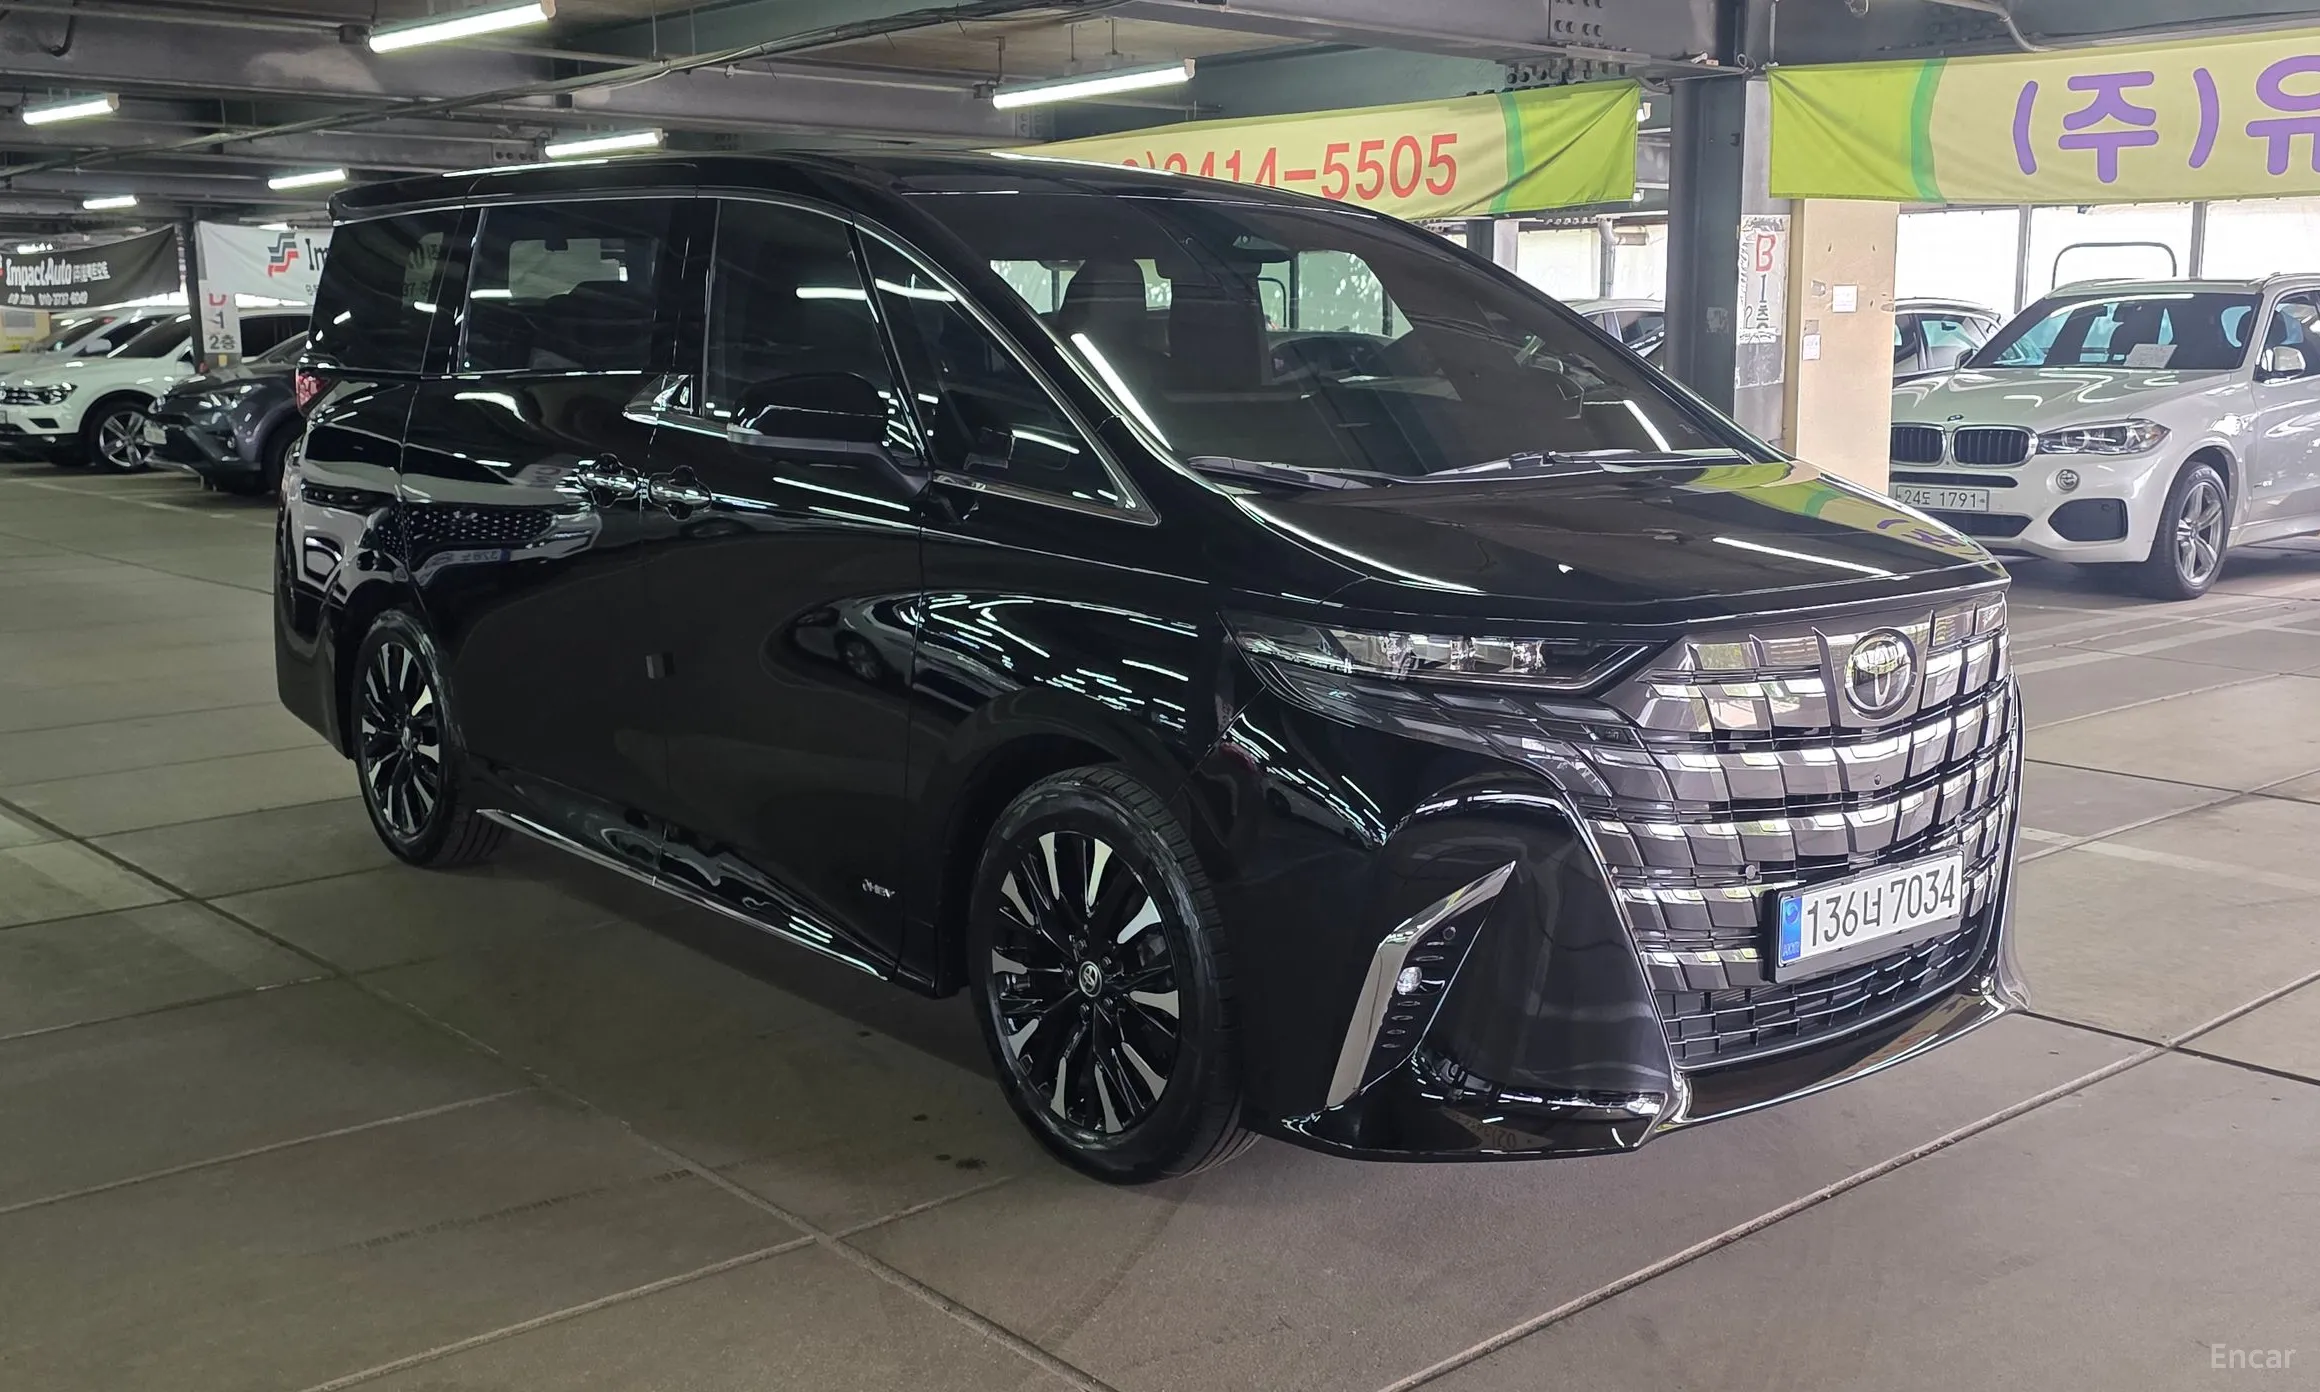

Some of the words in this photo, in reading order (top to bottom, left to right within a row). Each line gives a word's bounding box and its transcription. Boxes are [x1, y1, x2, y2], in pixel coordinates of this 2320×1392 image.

[1755, 233, 1776, 271] B
[1904, 489, 1931, 505] 24도
[1939, 491, 1977, 508] 1791
[1807, 887, 1881, 946] 136너
[1890, 865, 1955, 924] 7034
